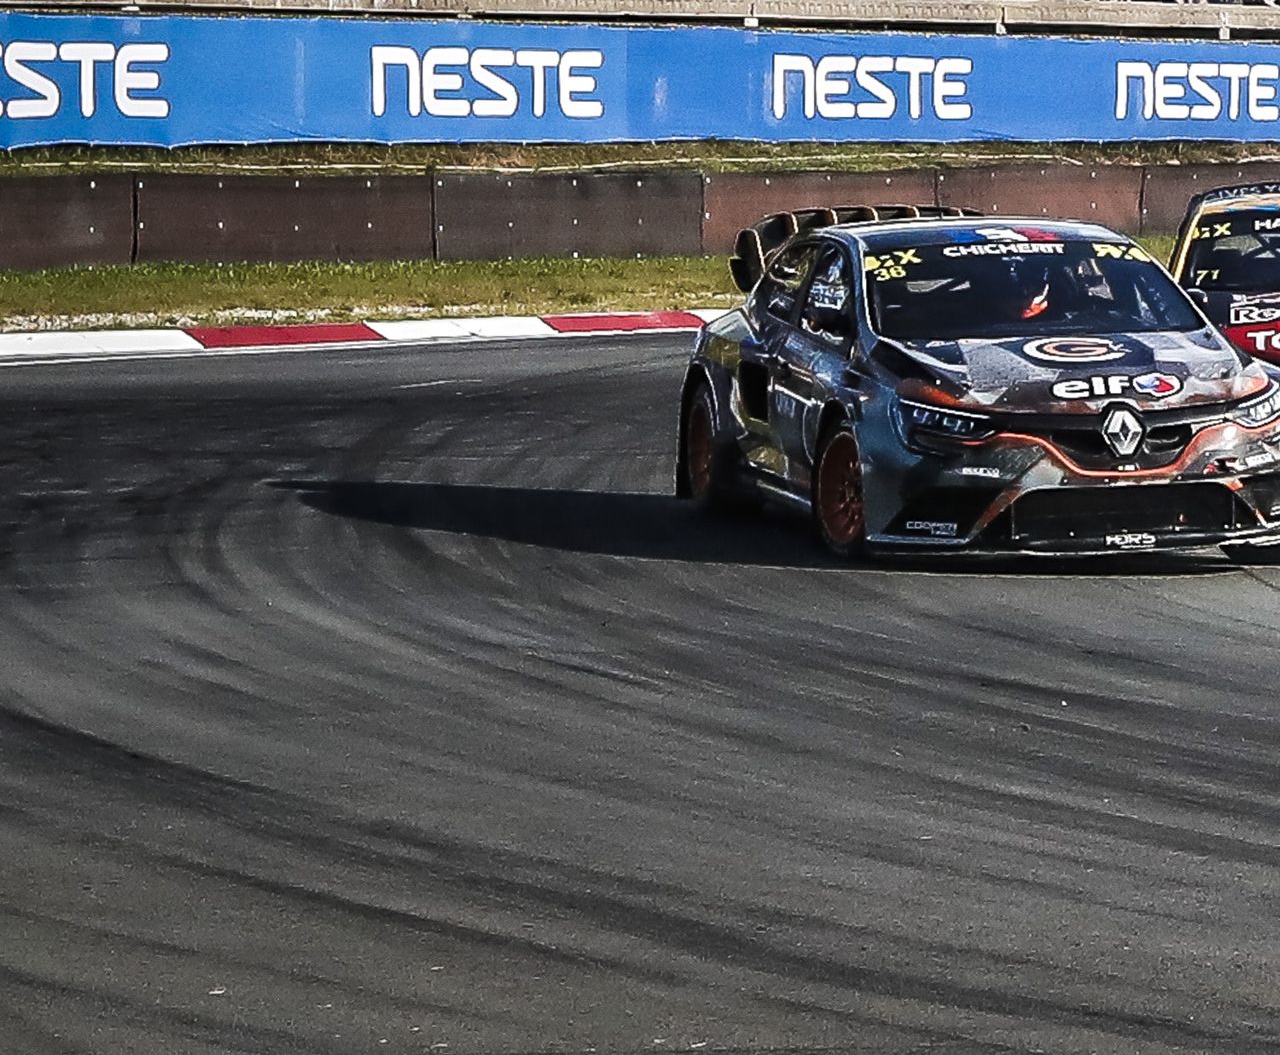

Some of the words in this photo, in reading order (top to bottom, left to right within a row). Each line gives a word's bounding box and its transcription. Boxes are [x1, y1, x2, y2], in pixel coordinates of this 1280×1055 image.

[0, 41, 170, 118] STE
[371, 45, 604, 118] NESTE
[772, 54, 973, 120] NESTE
[1115, 61, 1280, 121] NESTE
[943, 243, 1064, 257] CHICHERIT
[1053, 375, 1130, 398] elf
